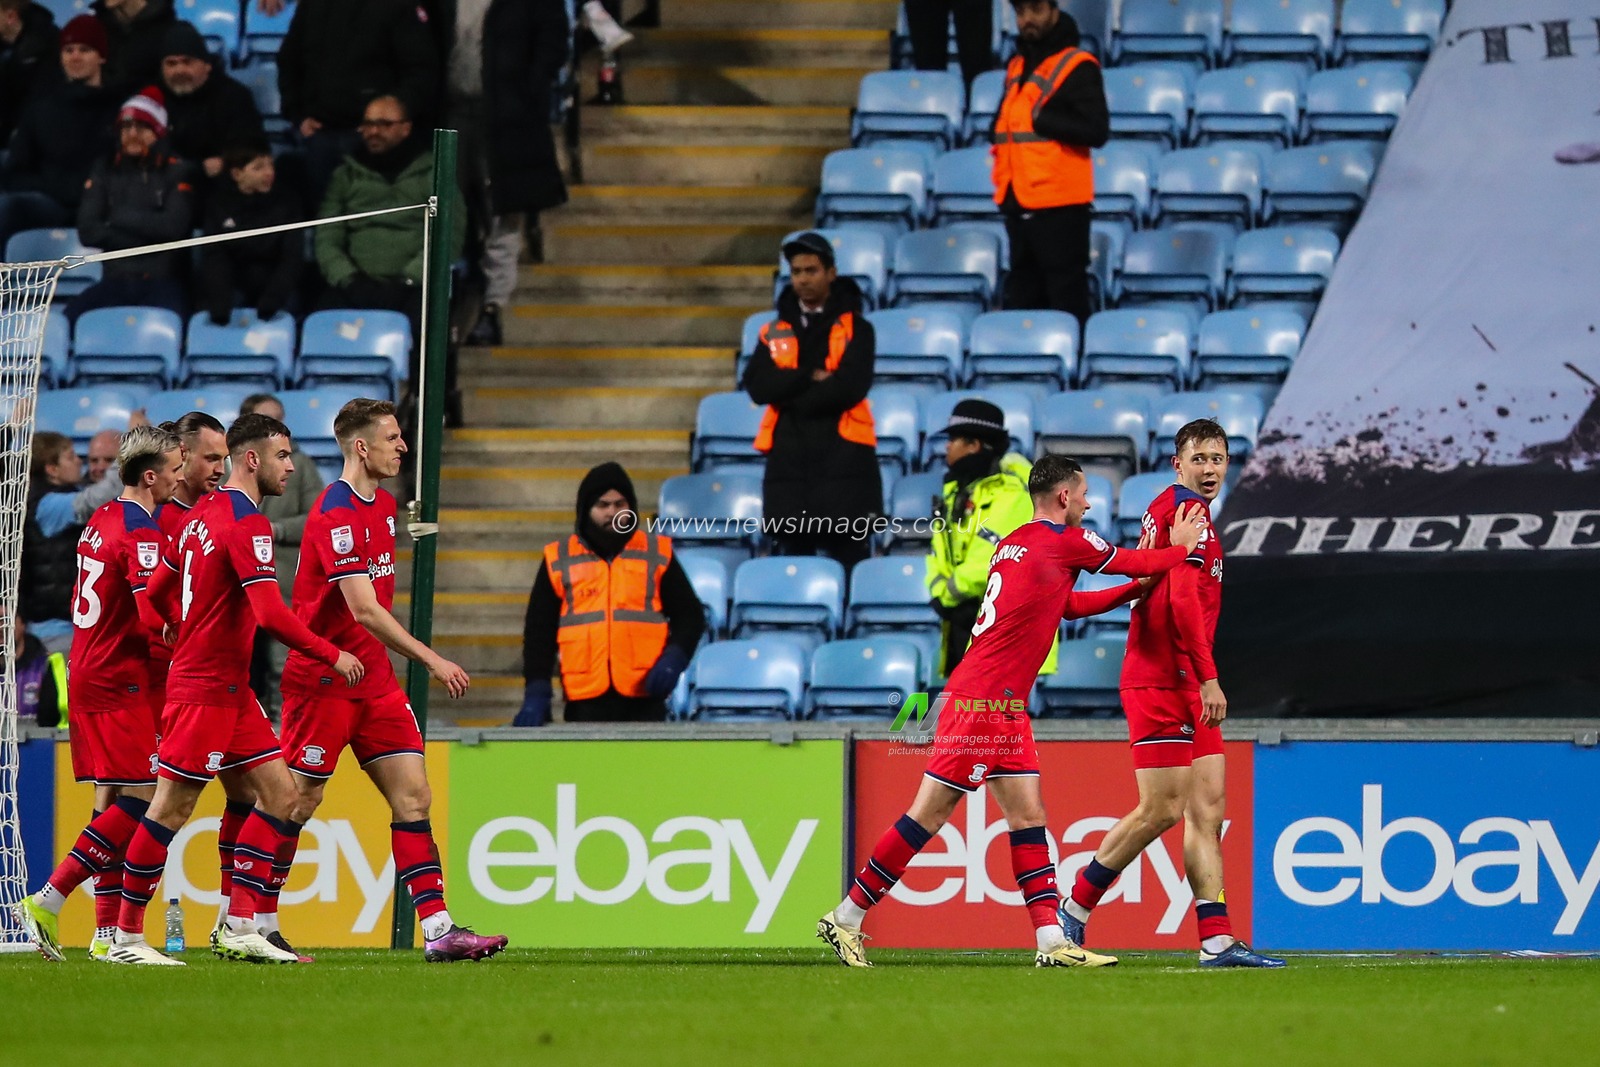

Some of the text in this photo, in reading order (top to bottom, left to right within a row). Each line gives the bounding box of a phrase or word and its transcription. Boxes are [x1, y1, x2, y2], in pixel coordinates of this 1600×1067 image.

[1223, 509, 1600, 557] THERE
[971, 571, 1003, 637] 8
[467, 783, 819, 933] ebay
[1273, 783, 1600, 935] ebay
